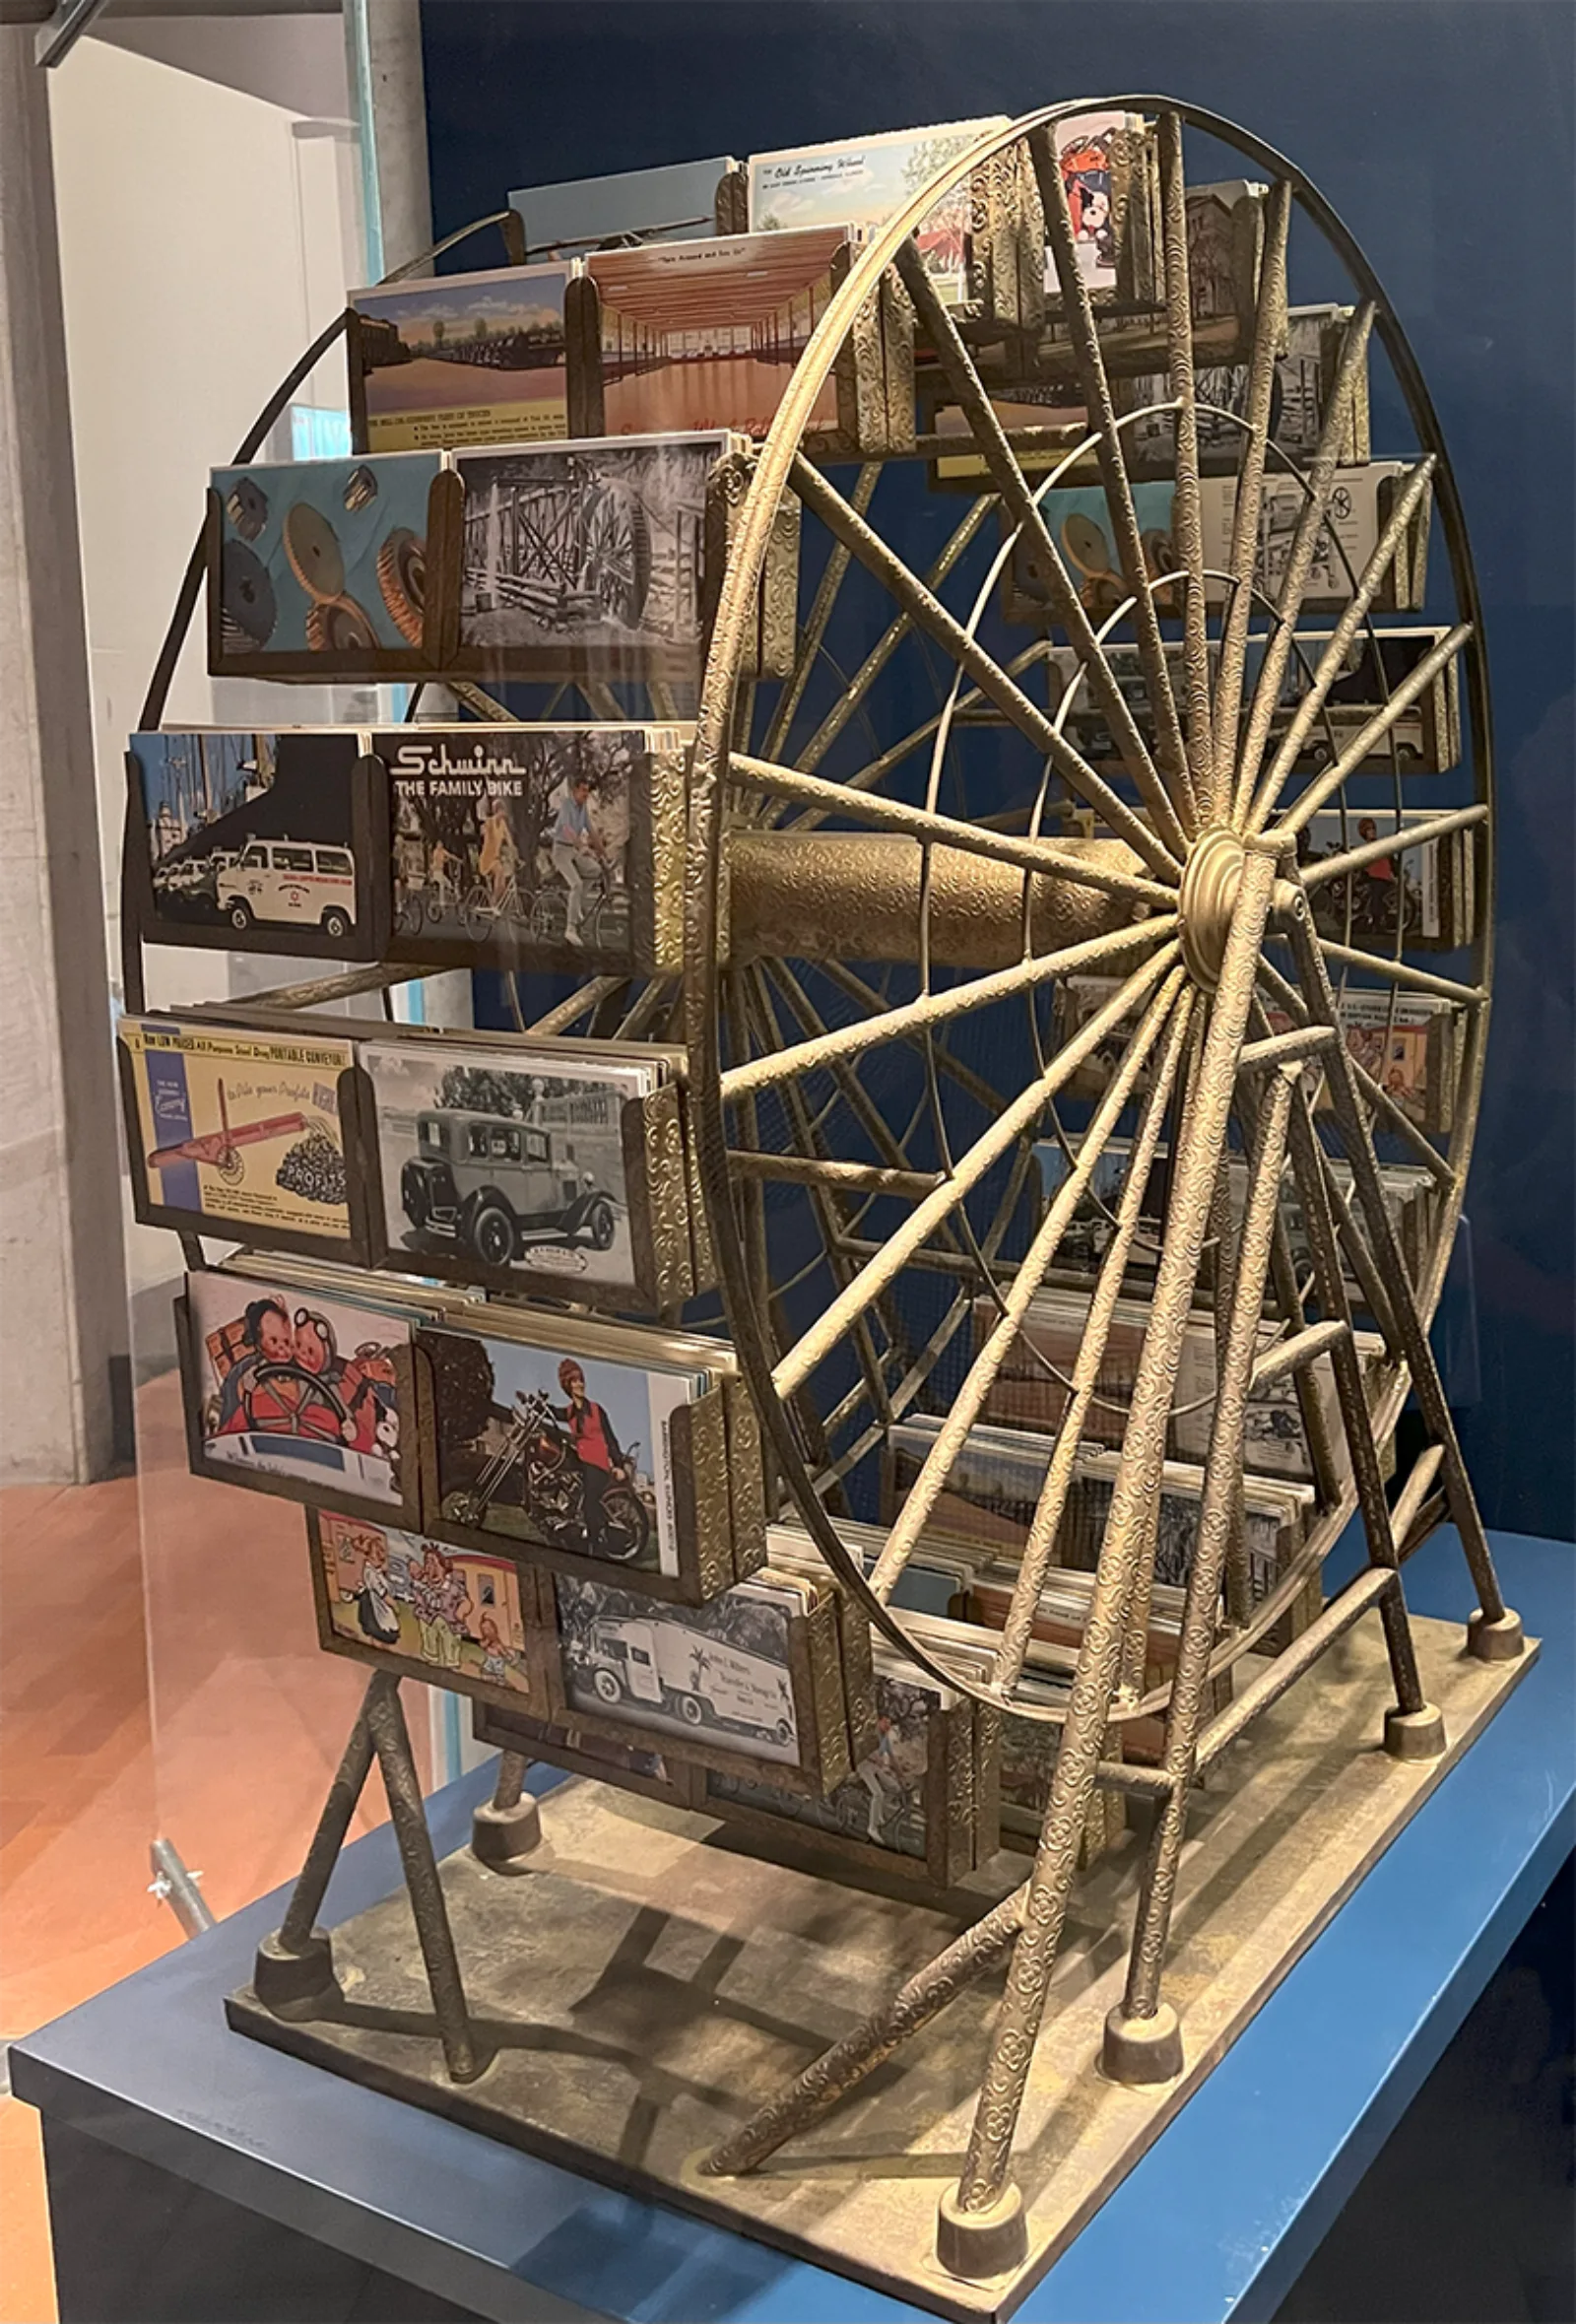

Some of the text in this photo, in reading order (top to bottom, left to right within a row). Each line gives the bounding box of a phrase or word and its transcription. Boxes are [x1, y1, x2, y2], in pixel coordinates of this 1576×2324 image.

[389, 743, 527, 775] Schwinn
[394, 779, 523, 796] THE FAMILY BIKE
[288, 1164, 347, 1187] PROFITS
